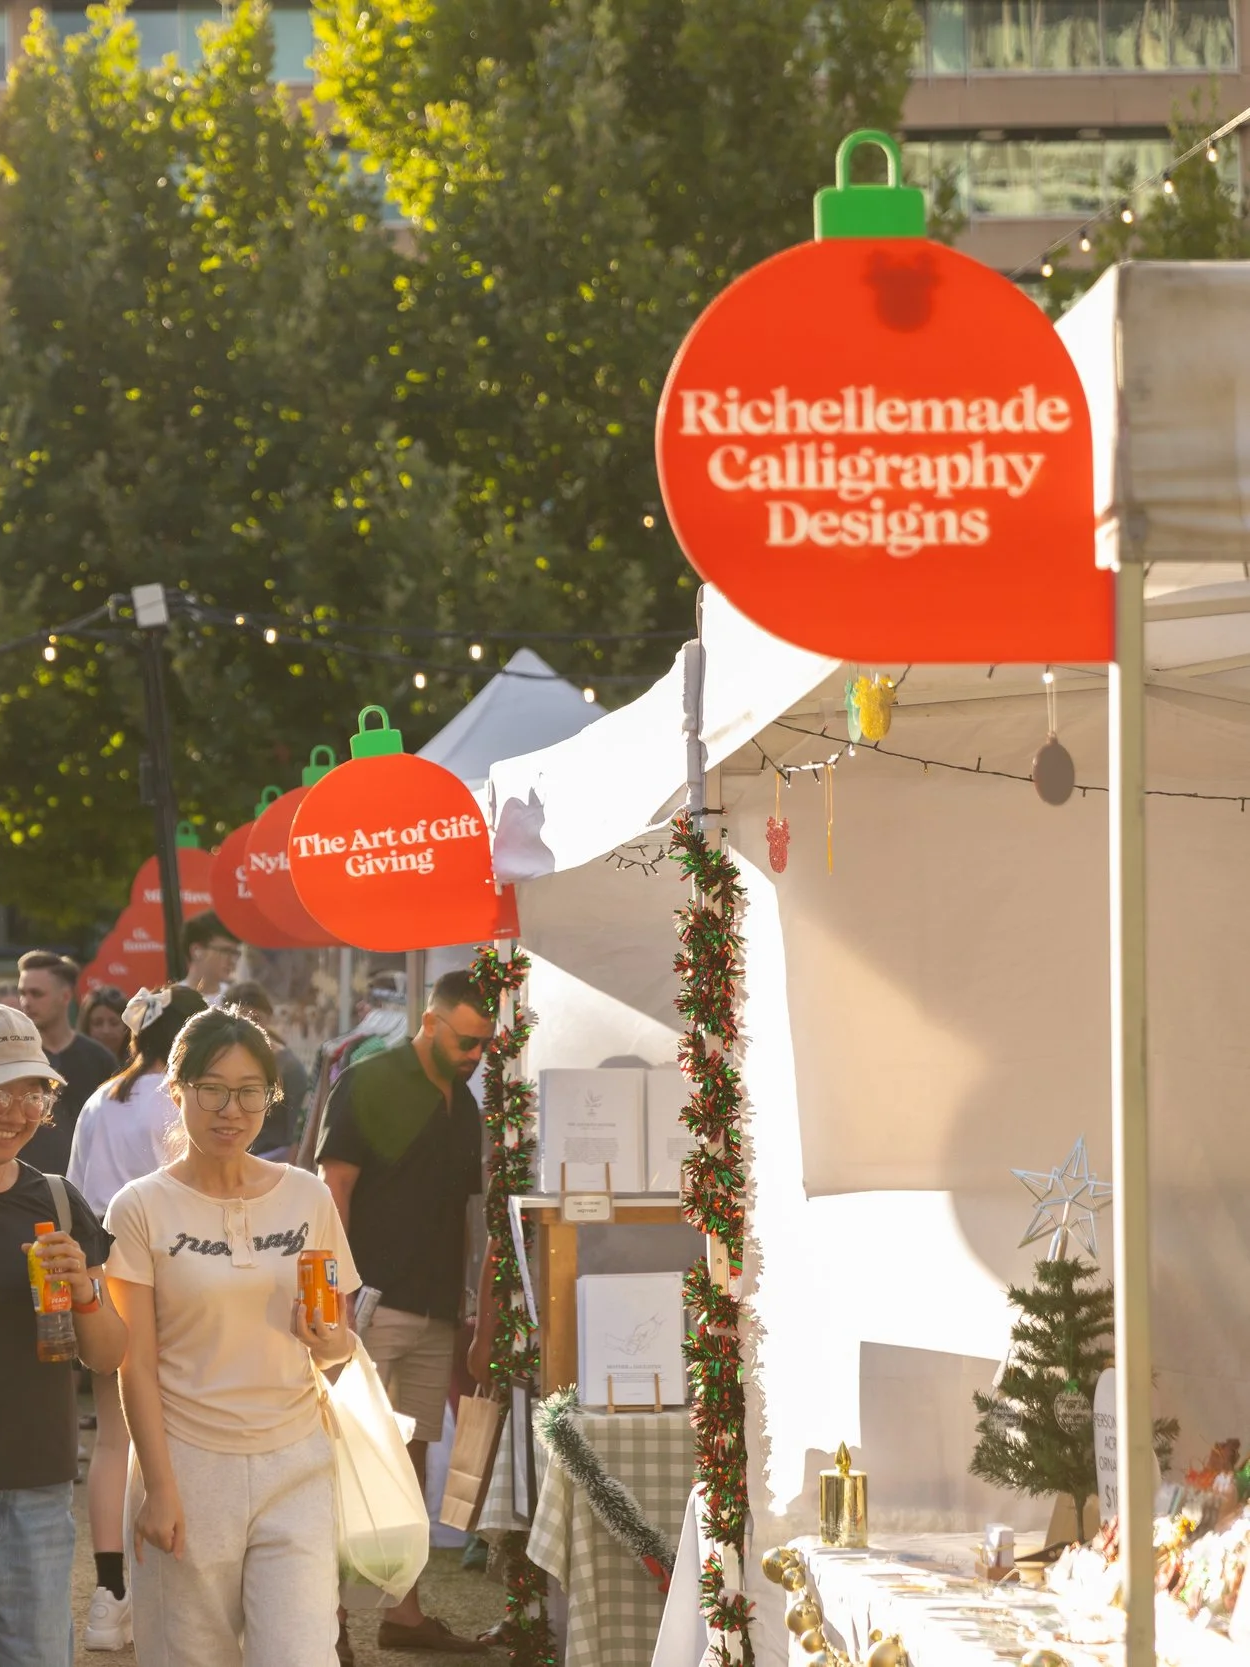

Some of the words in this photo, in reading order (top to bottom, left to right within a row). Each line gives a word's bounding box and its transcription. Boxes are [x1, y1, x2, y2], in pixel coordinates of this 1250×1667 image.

[679, 384, 1072, 436] Richellemade
[707, 441, 1046, 501] Calligraphy
[765, 496, 990, 558] Designs
[293, 832, 347, 858] The
[349, 826, 399, 852] Art
[400, 819, 428, 845] of
[429, 814, 482, 841] Gift
[345, 848, 435, 878] Giving
[1093, 1413, 1116, 1429] PERSON
[1104, 1435, 1116, 1449] ACR
[1099, 1456, 1117, 1471] ORNA
